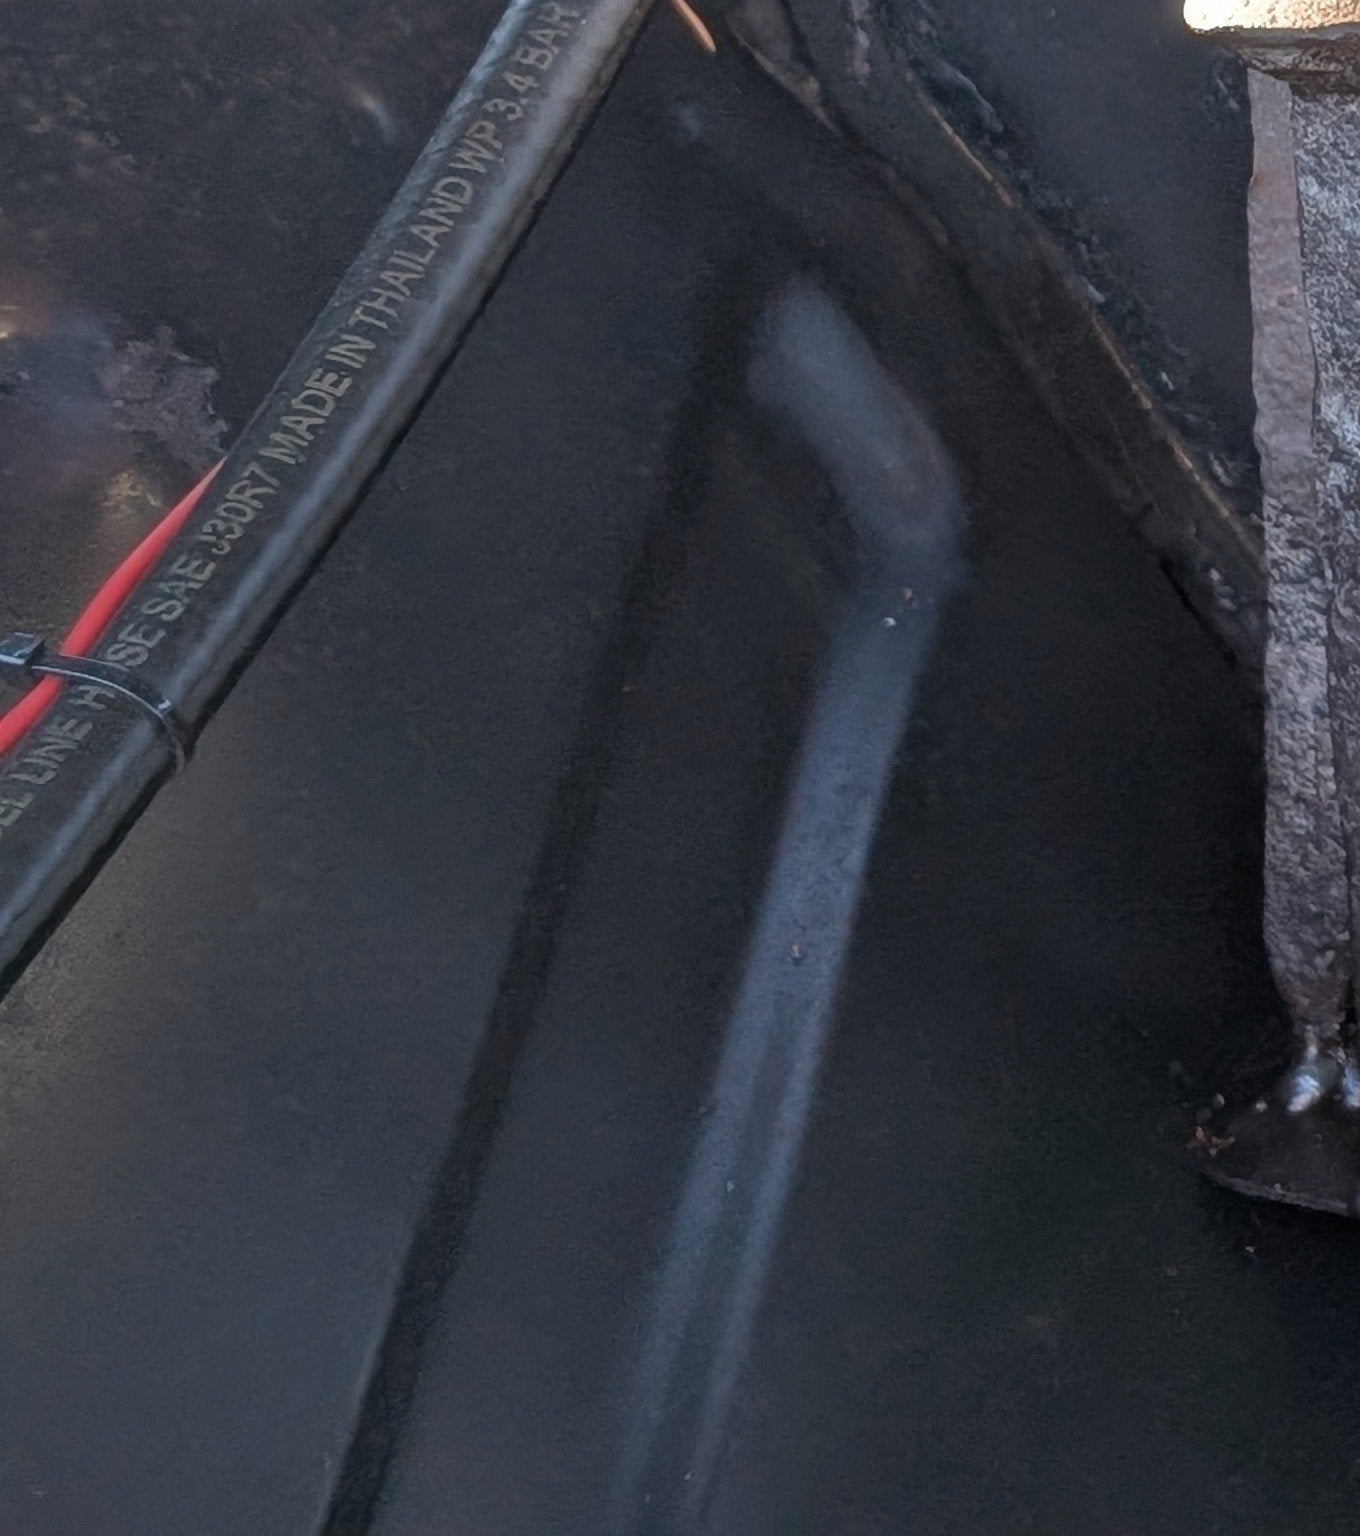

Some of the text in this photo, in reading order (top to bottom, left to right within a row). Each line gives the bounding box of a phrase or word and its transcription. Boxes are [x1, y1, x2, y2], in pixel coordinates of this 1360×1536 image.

[509, 0, 579, 70] BAR
[483, 71, 538, 120] 3.4
[448, 119, 502, 171] WP
[348, 175, 474, 328] THAILAND
[325, 333, 376, 368] IN
[258, 366, 352, 463] MADE
[197, 459, 280, 553] J30R7
[140, 552, 217, 623] SAE
[68, 622, 166, 712] HSE
[9, 718, 93, 785] LINE
